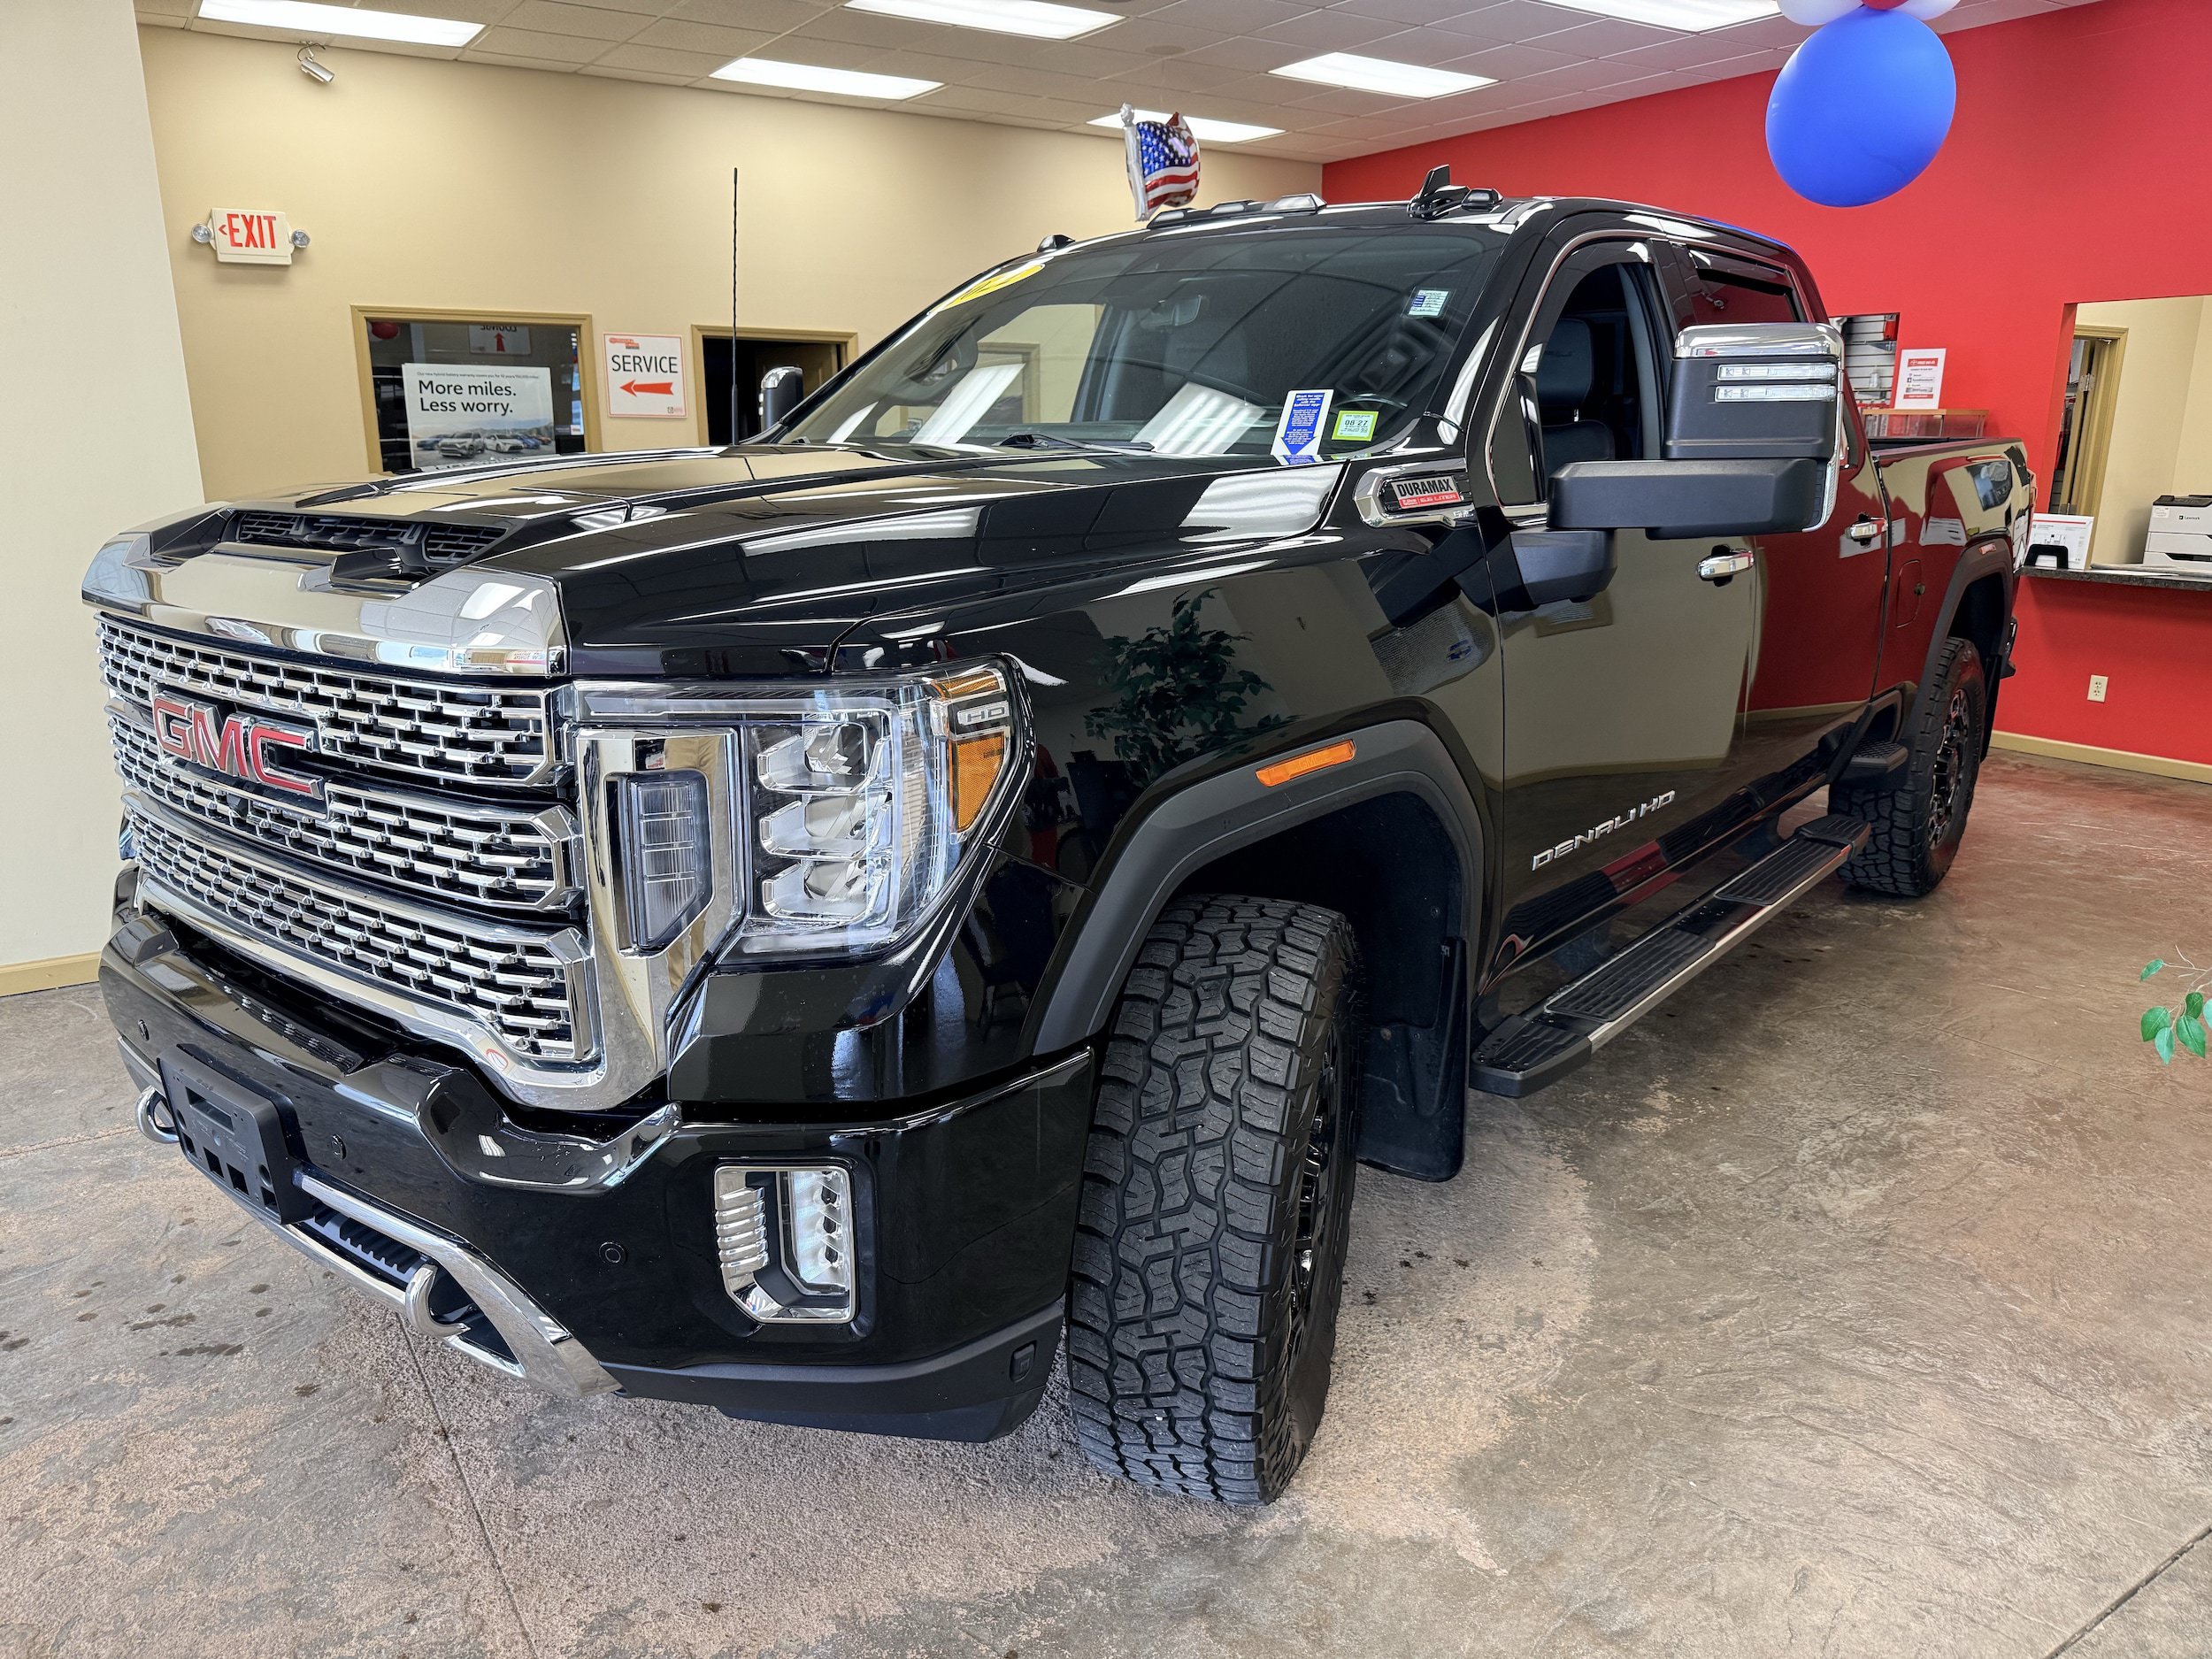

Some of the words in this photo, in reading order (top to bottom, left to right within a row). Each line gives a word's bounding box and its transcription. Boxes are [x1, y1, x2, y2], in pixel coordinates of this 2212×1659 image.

[227, 213, 277, 250] EXIT
[611, 354, 679, 373] SERVICE
[419, 380, 463, 395] More
[468, 380, 517, 396] miles.
[420, 397, 457, 411] Less
[461, 400, 513, 416] worry.
[1396, 479, 1454, 496] DURAMAX
[967, 706, 1005, 723] HD
[153, 694, 325, 800] GMC
[1532, 808, 1636, 871] DENALI
[1639, 790, 1676, 818] HD
